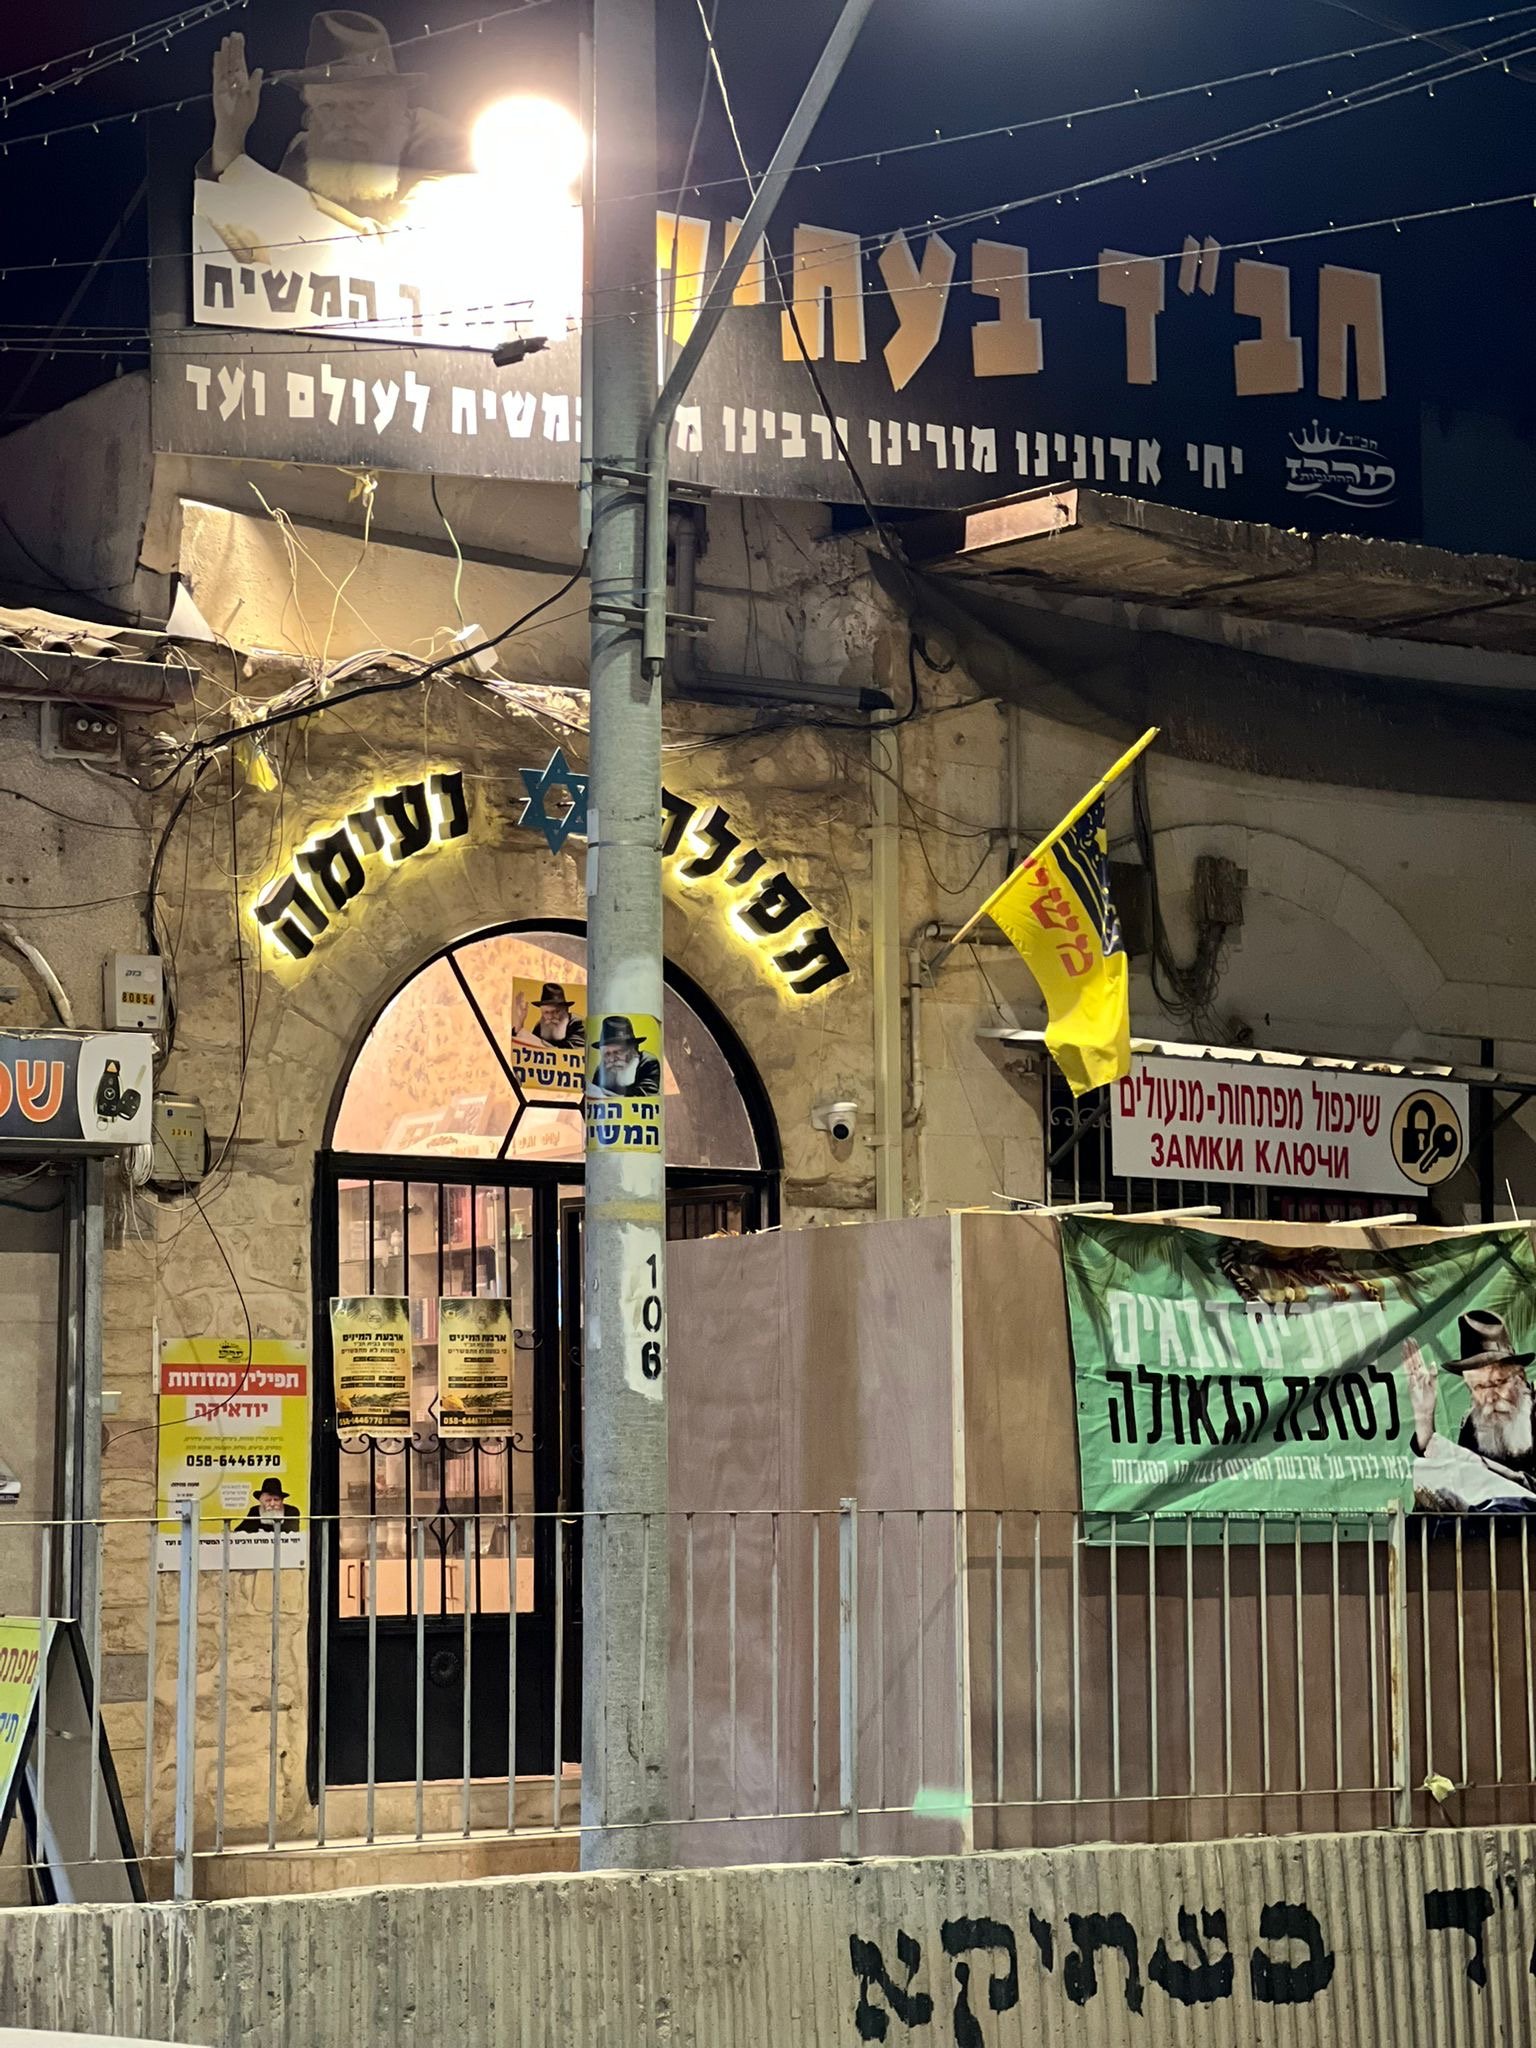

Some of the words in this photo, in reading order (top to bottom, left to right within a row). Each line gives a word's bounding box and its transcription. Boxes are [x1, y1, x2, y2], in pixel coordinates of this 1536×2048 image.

[203, 263, 378, 323] המשיח
[1099, 234, 1387, 400] חב"ד
[186, 364, 265, 422] ועד
[287, 363, 430, 435] לעולם
[452, 385, 582, 443] משיח
[722, 405, 848, 461] ורבינו
[868, 418, 997, 473] מורינו
[1015, 430, 1161, 487] אדונינו
[1186, 442, 1243, 489] יחי
[254, 770, 469, 960] נעימה
[512, 1048, 557, 1066] המלך
[590, 1125, 659, 1145] המשי
[632, 1103, 660, 1119] יחי
[1312, 1081, 1381, 1137] שיכפול
[1150, 1133, 1243, 1173] ЗАМКИ
[1256, 1139, 1349, 1179] КЛЮЧИ
[641, 1253, 662, 1380] 106
[1109, 1288, 1243, 1369] הבאים
[167, 1371, 237, 1388] ומזוזות
[241, 1370, 300, 1392] תפילין
[1106, 1364, 1270, 1446] הגאולה
[1274, 1365, 1400, 1442] לסוכת
[194, 1402, 269, 1421] יודאיקה
[185, 1454, 281, 1467] 058-6446770
[1273, 1456, 1322, 1480] ארבעת
[1324, 1453, 1345, 1480] על
[1345, 1453, 1380, 1481] לברך
